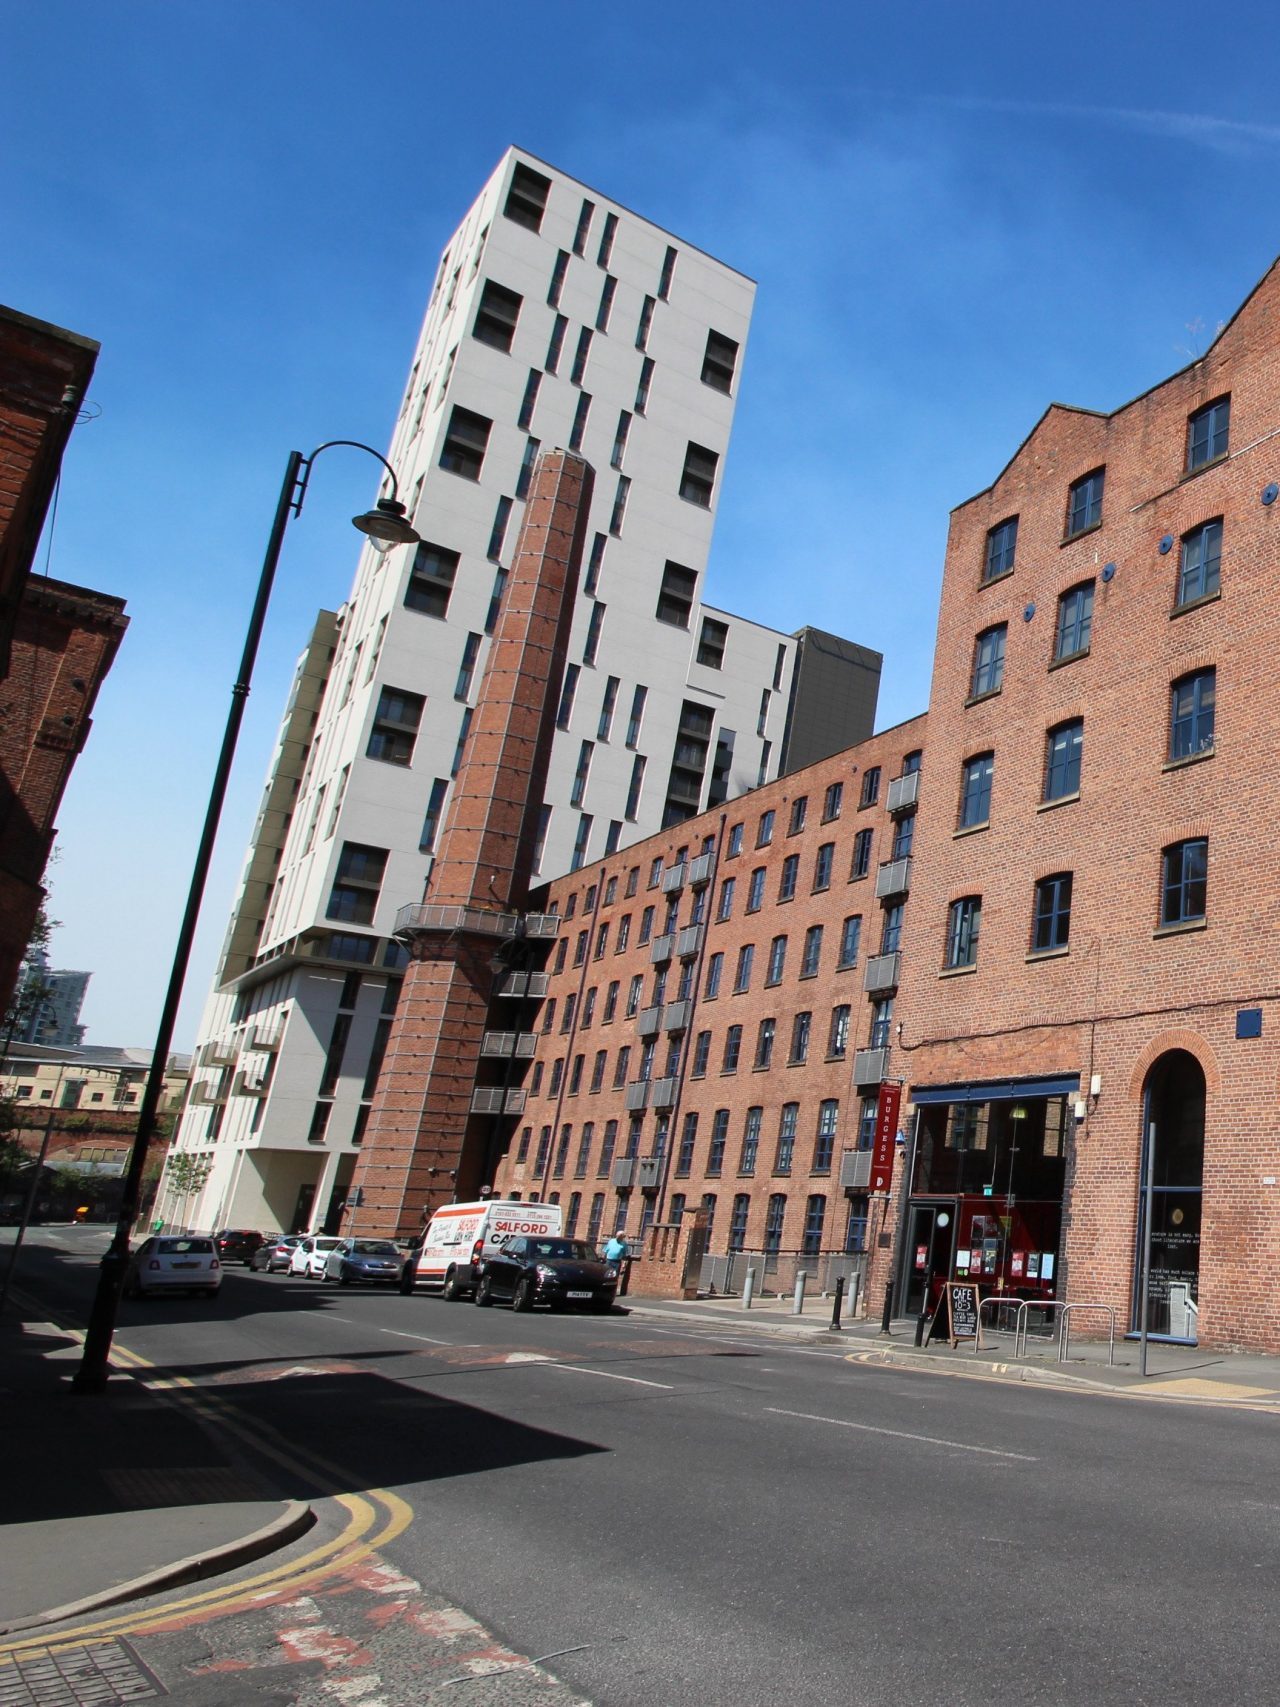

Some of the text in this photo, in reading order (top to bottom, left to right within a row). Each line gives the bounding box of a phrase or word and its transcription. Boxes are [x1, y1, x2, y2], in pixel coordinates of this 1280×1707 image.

[879, 1097, 892, 1161] BURGESS
[495, 1221, 548, 1234] SALFORD
[953, 1288, 972, 1301] CAFE
[954, 1301, 971, 1310] 10-3
